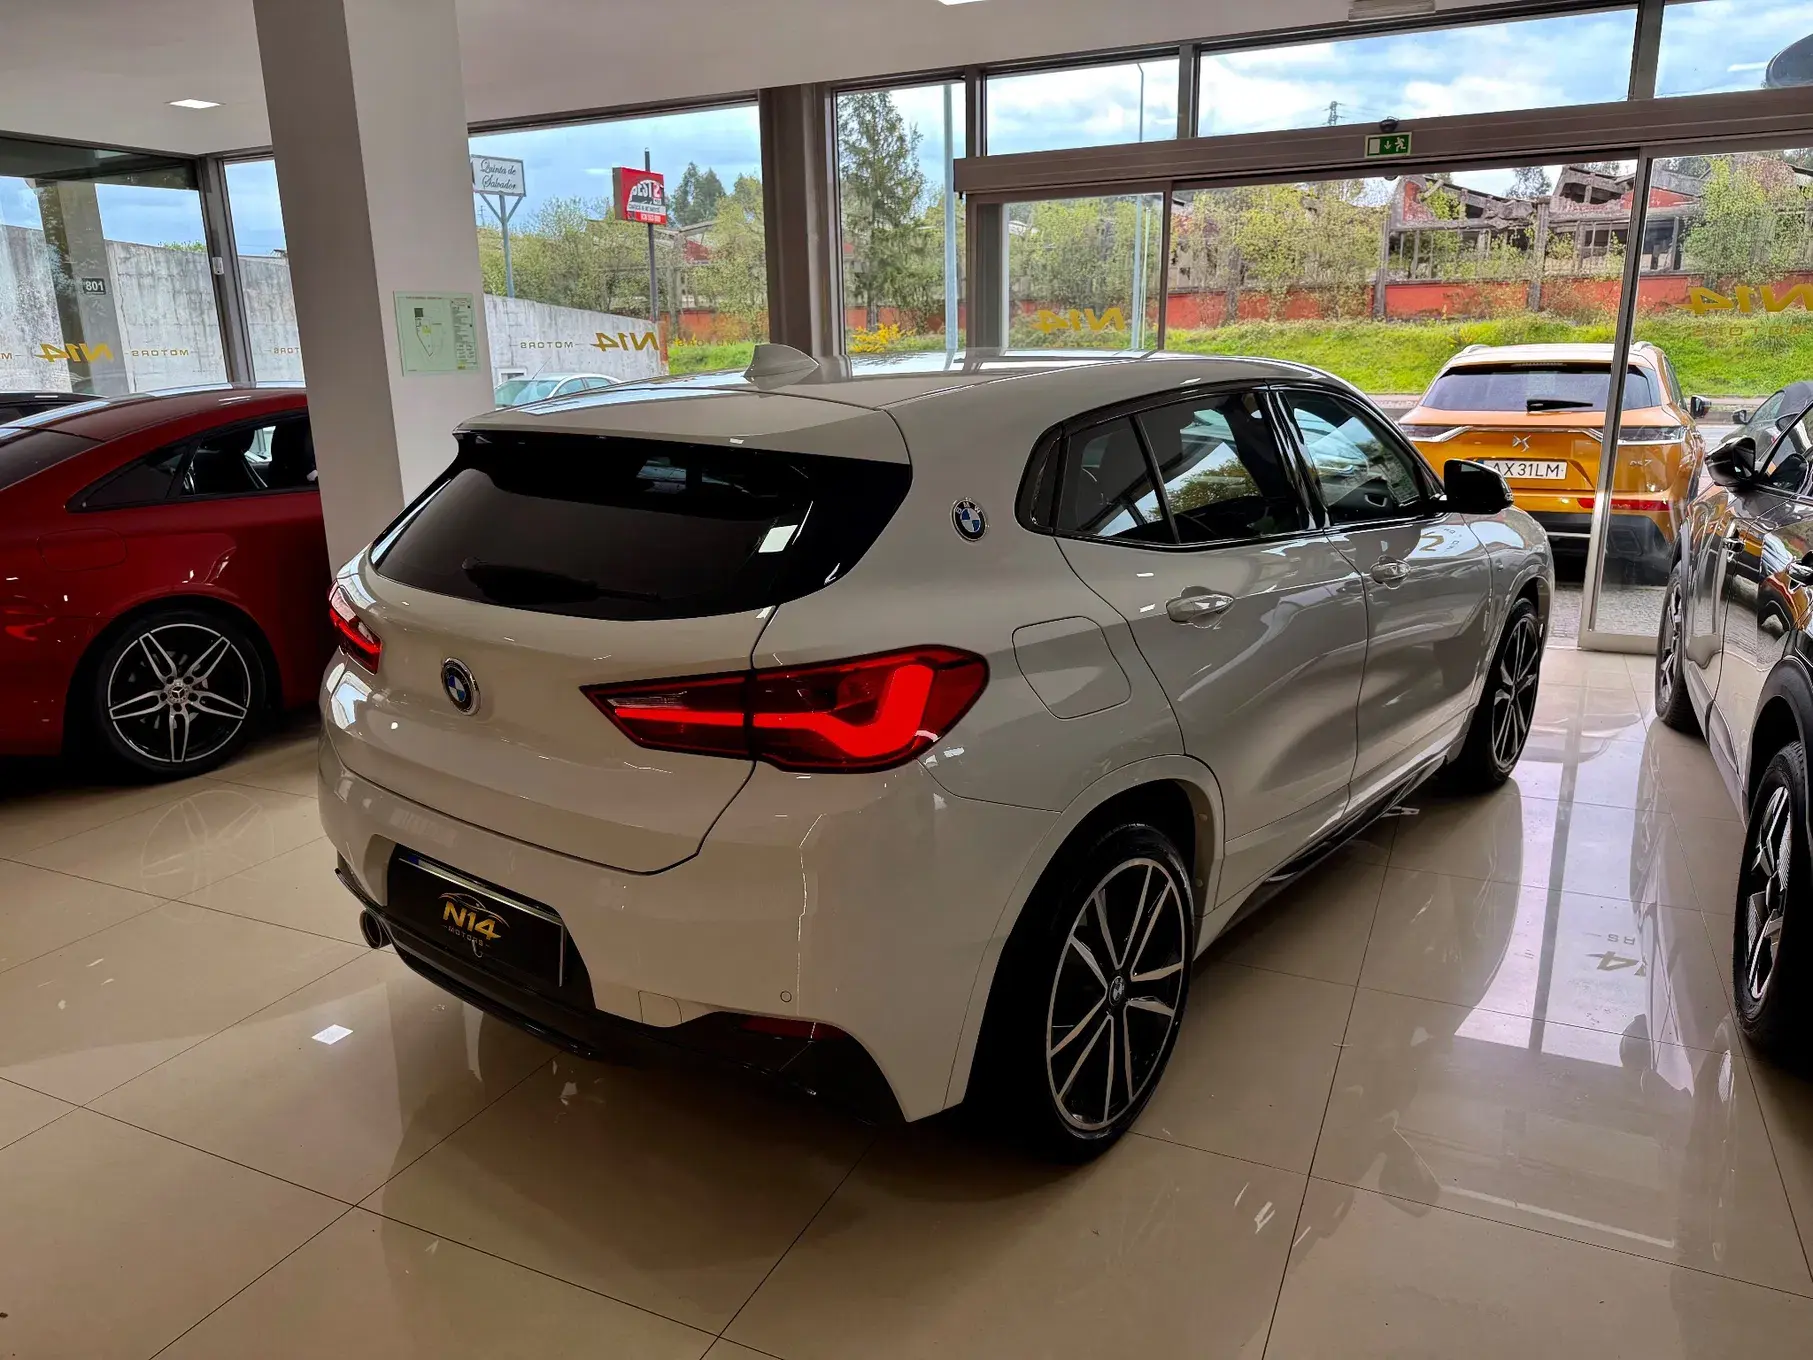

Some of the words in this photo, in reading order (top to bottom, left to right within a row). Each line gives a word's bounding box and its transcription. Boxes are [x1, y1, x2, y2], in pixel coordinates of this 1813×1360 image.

[480, 158, 507, 174] Quinta
[507, 165, 516, 175] de
[85, 281, 104, 291] 801
[443, 900, 502, 940] N14
[448, 925, 484, 947] MOTORS
